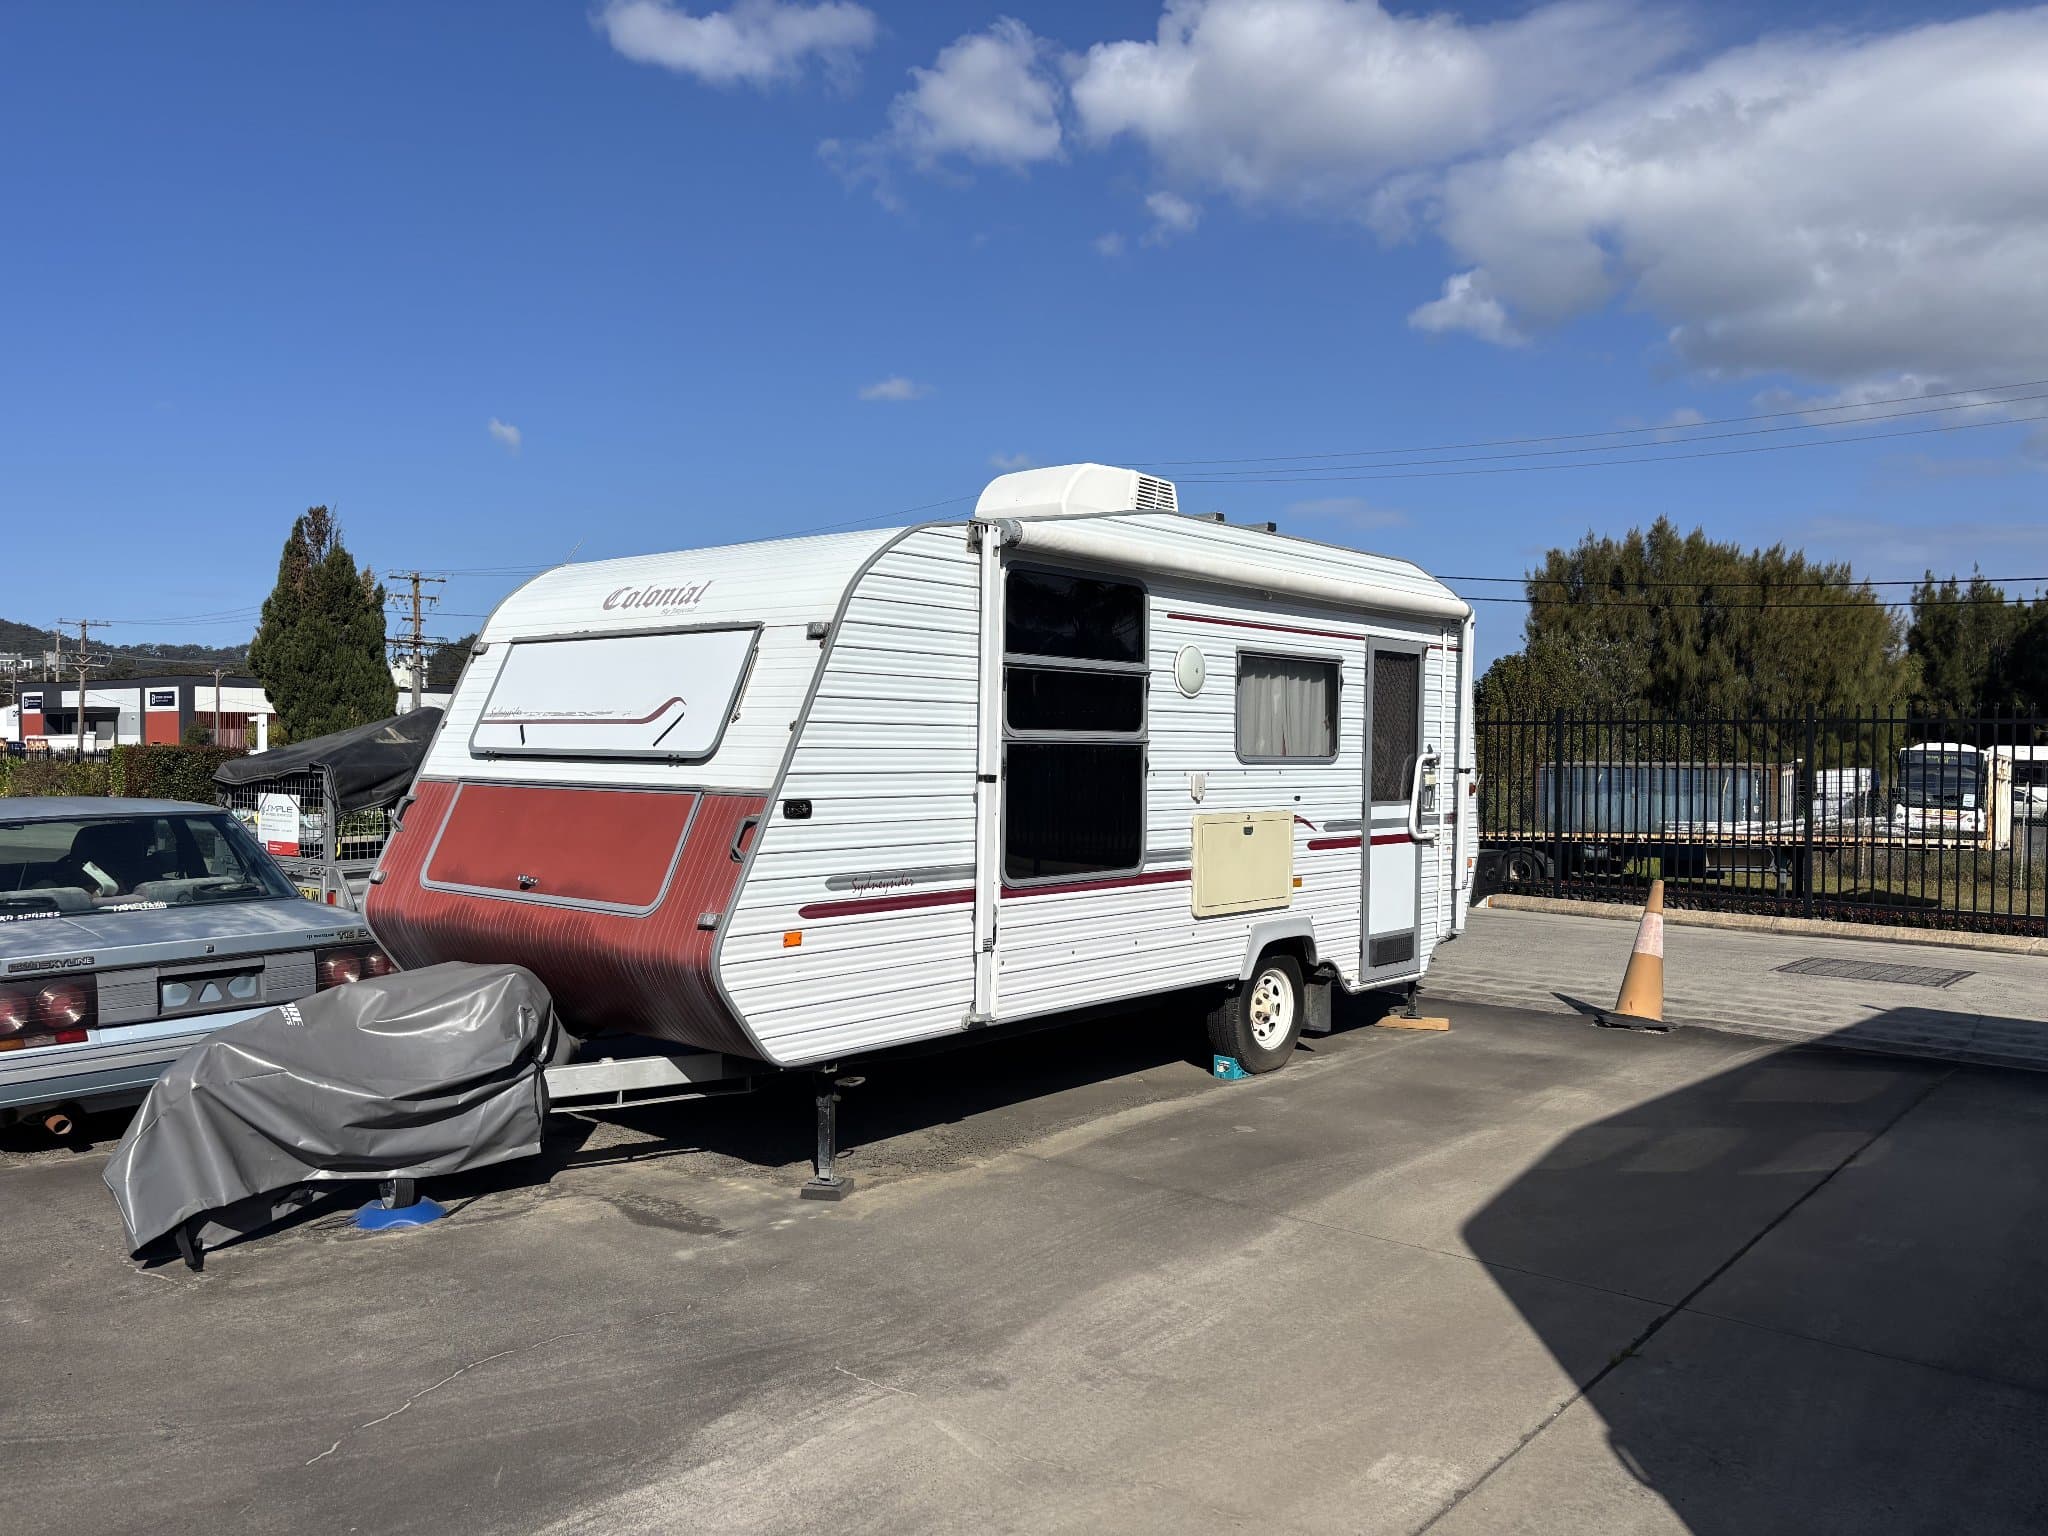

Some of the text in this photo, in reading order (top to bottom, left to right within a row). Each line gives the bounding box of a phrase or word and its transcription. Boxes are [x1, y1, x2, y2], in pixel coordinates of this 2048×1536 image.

[603, 579, 713, 611] Colonial
[852, 871, 914, 897] Sydneysider
[39, 955, 95, 970] SKYLINE
